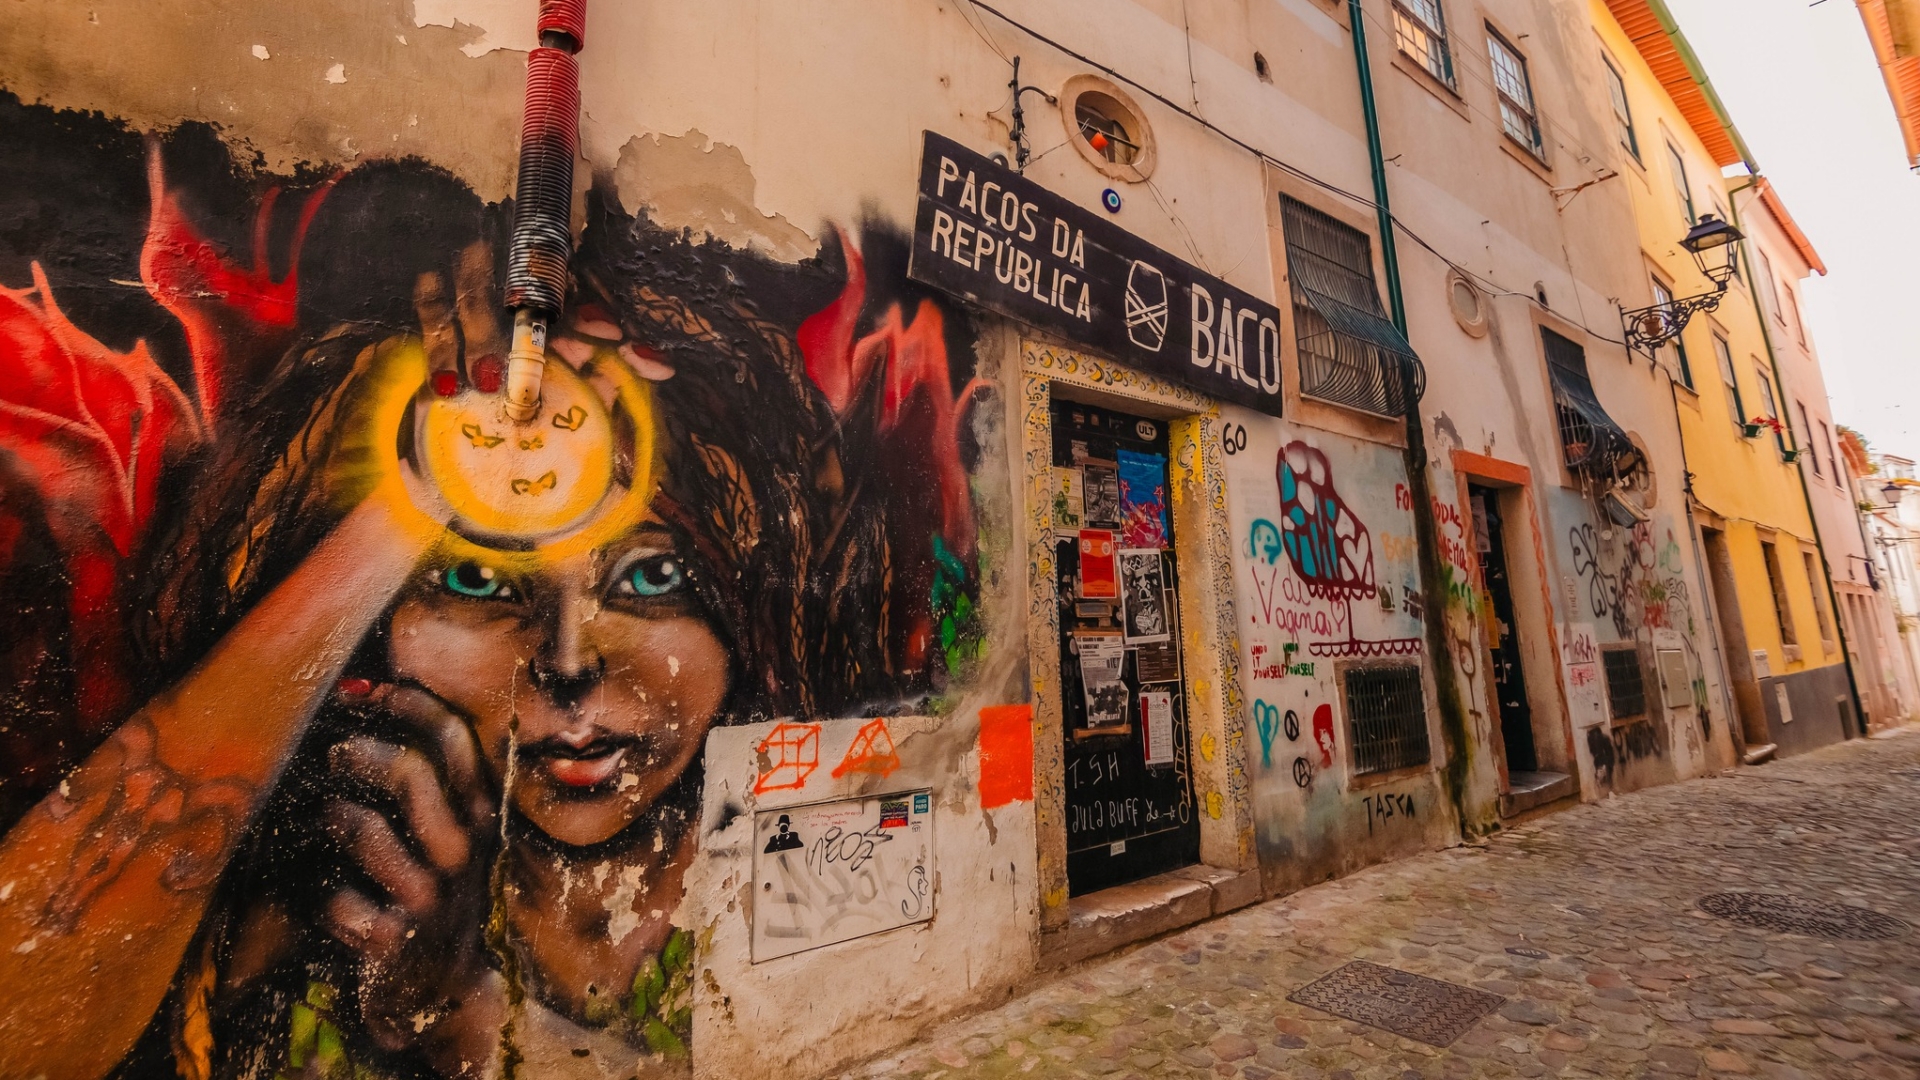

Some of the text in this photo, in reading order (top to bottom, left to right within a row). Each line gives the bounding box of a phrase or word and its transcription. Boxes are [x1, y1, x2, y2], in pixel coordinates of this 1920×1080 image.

[936, 156, 1085, 269] PAÇOS DA
[930, 209, 1091, 323] REPÚBLICA
[1190, 283, 1281, 395] BACO
[1138, 425, 1155, 437] ULT
[1223, 423, 1247, 455] 60
[1363, 793, 1416, 837] TASCA
